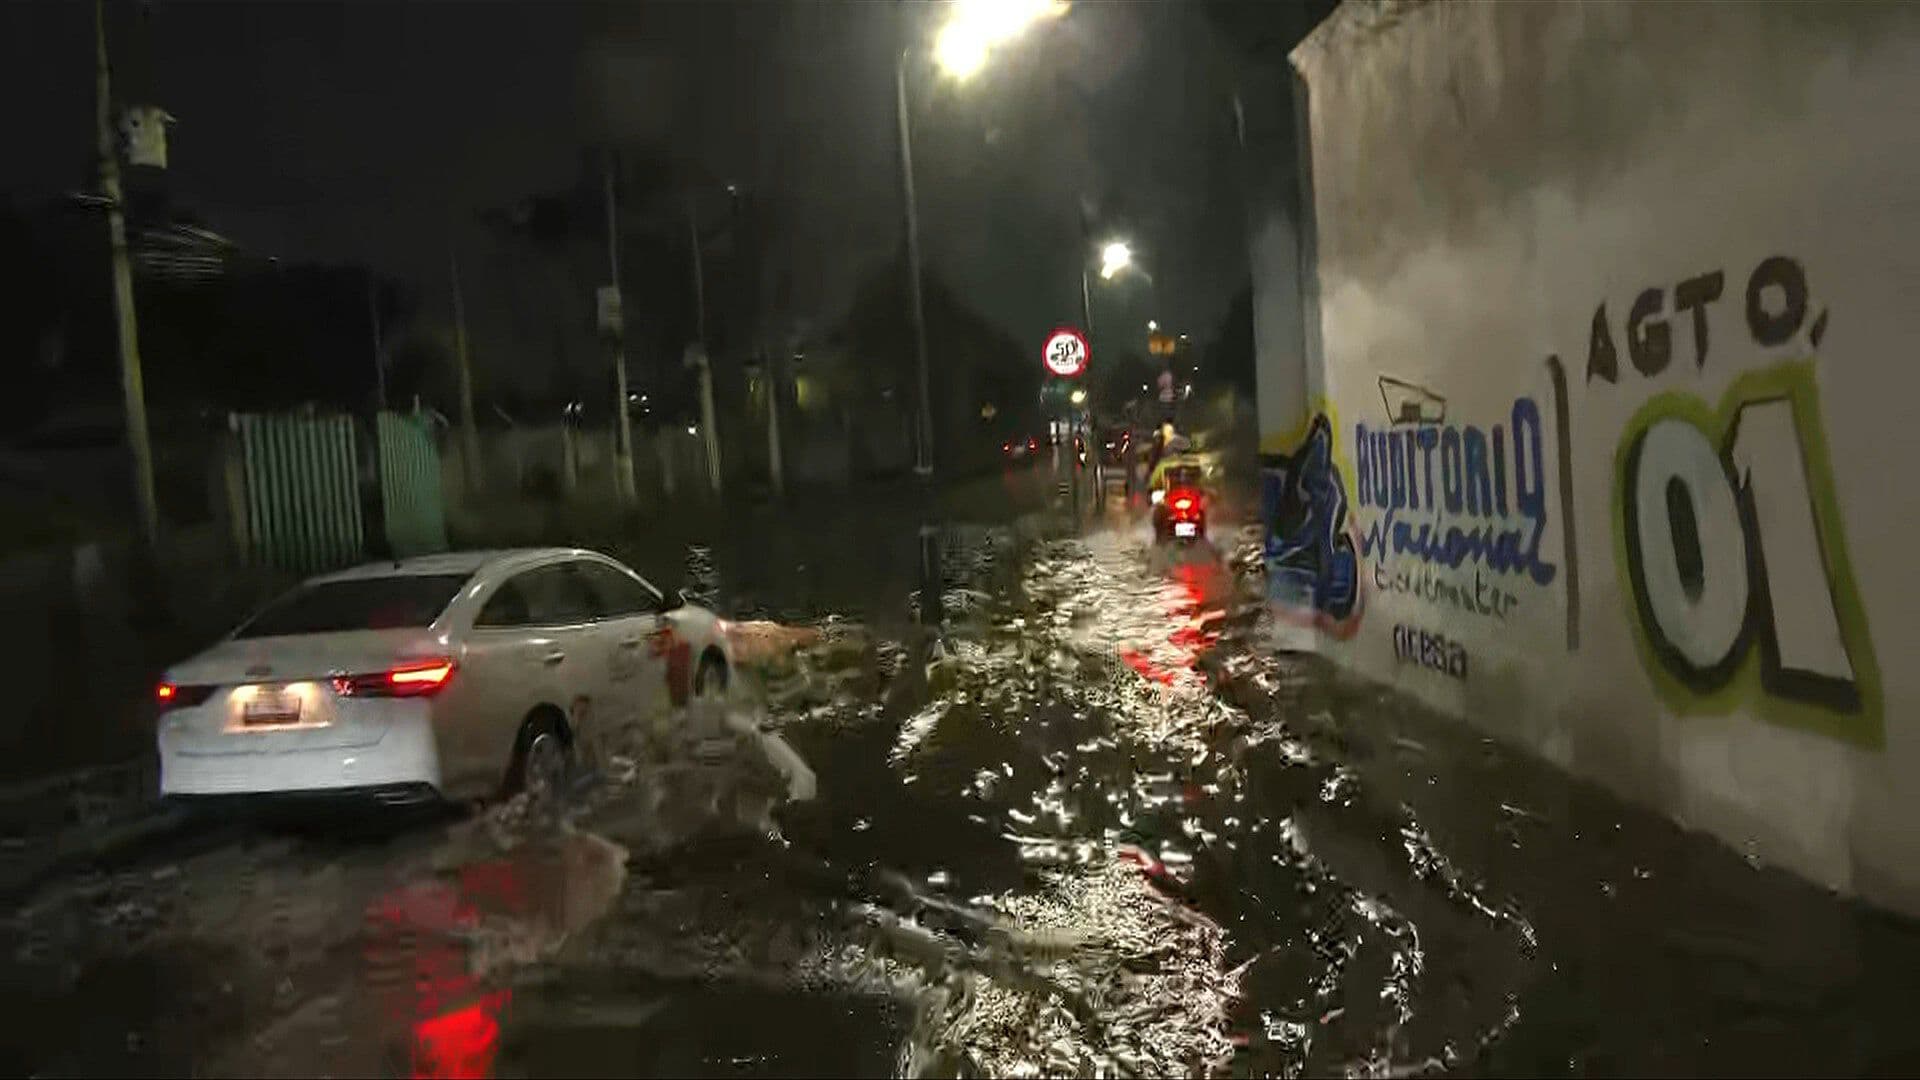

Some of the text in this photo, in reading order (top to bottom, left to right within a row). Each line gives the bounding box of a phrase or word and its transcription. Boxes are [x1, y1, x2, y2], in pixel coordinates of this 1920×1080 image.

[1356, 397, 1544, 518] AUDITORIO
[1362, 511, 1556, 586] Nacional
[1620, 393, 1865, 716] 01
